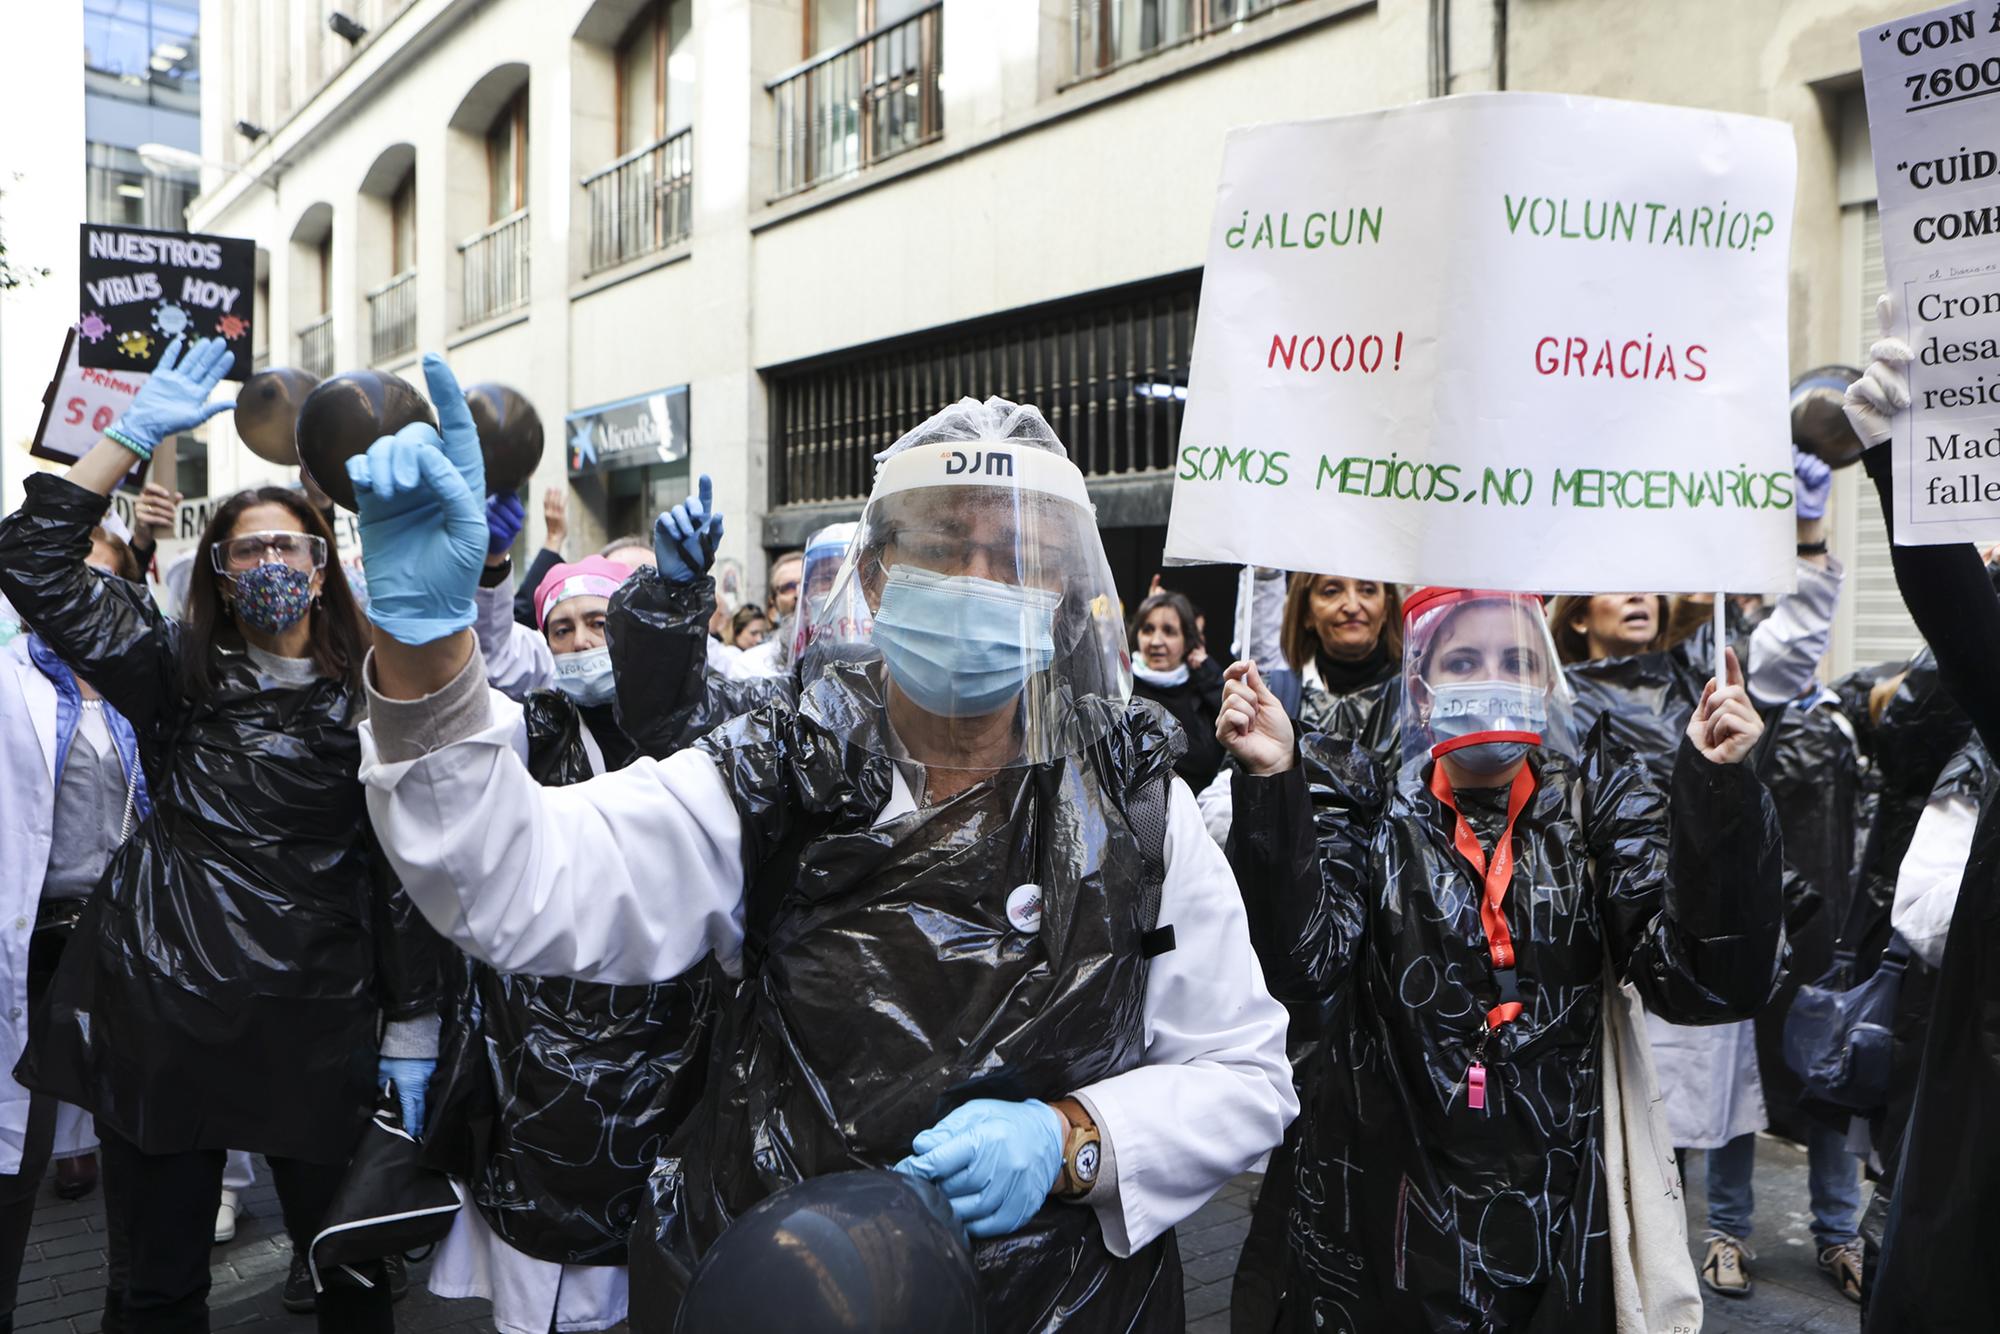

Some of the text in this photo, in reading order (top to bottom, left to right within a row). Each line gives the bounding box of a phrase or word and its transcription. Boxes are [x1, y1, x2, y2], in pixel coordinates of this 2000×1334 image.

[1897, 147, 2000, 189] “CUID
[89, 230, 222, 270] NUESTROS
[86, 272, 240, 313] VIRUS HOY
[1535, 332, 1708, 382] GRACIAS
[946, 451, 1013, 477] DJM
[1179, 445, 1291, 486] SOMOS
[1552, 463, 1794, 510] MERCENARIOS
